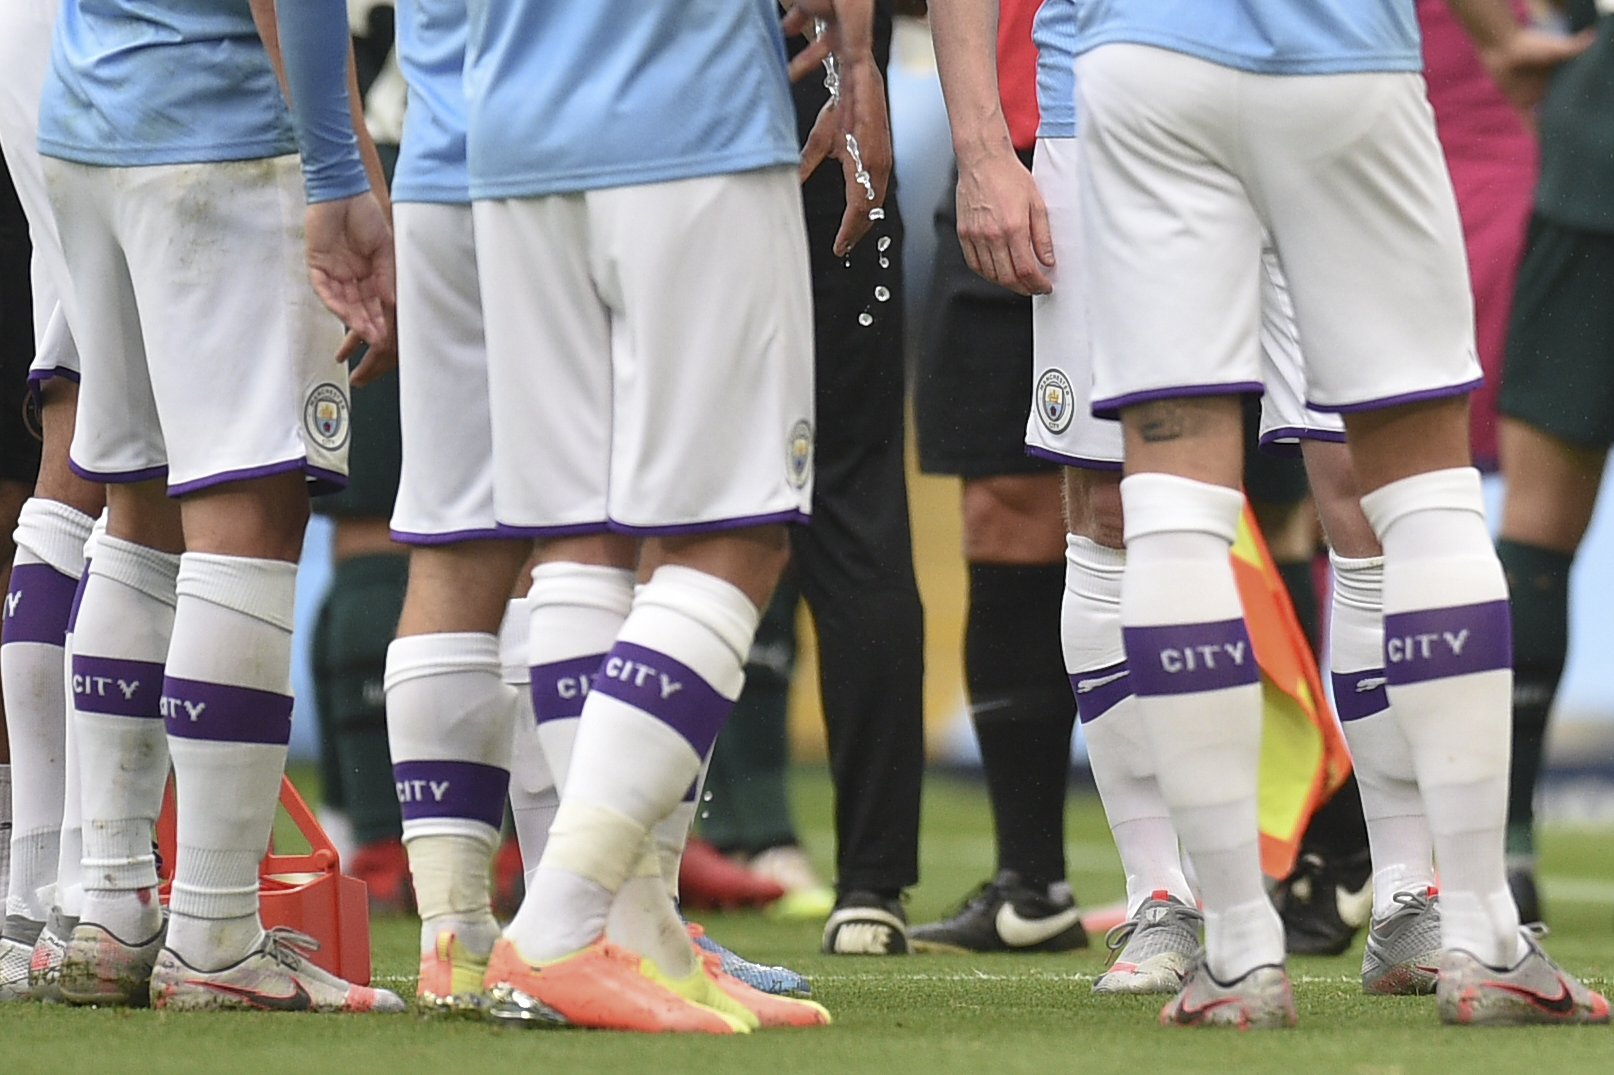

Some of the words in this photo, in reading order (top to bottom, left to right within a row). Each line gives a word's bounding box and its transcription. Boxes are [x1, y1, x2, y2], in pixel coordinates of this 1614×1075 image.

[1159, 641, 1246, 674] CITY
[1387, 629, 1470, 663] CITY
[72, 677, 139, 700] CITY
[556, 672, 599, 700] CI
[605, 656, 683, 699] CITY
[834, 923, 892, 954] NIKE
